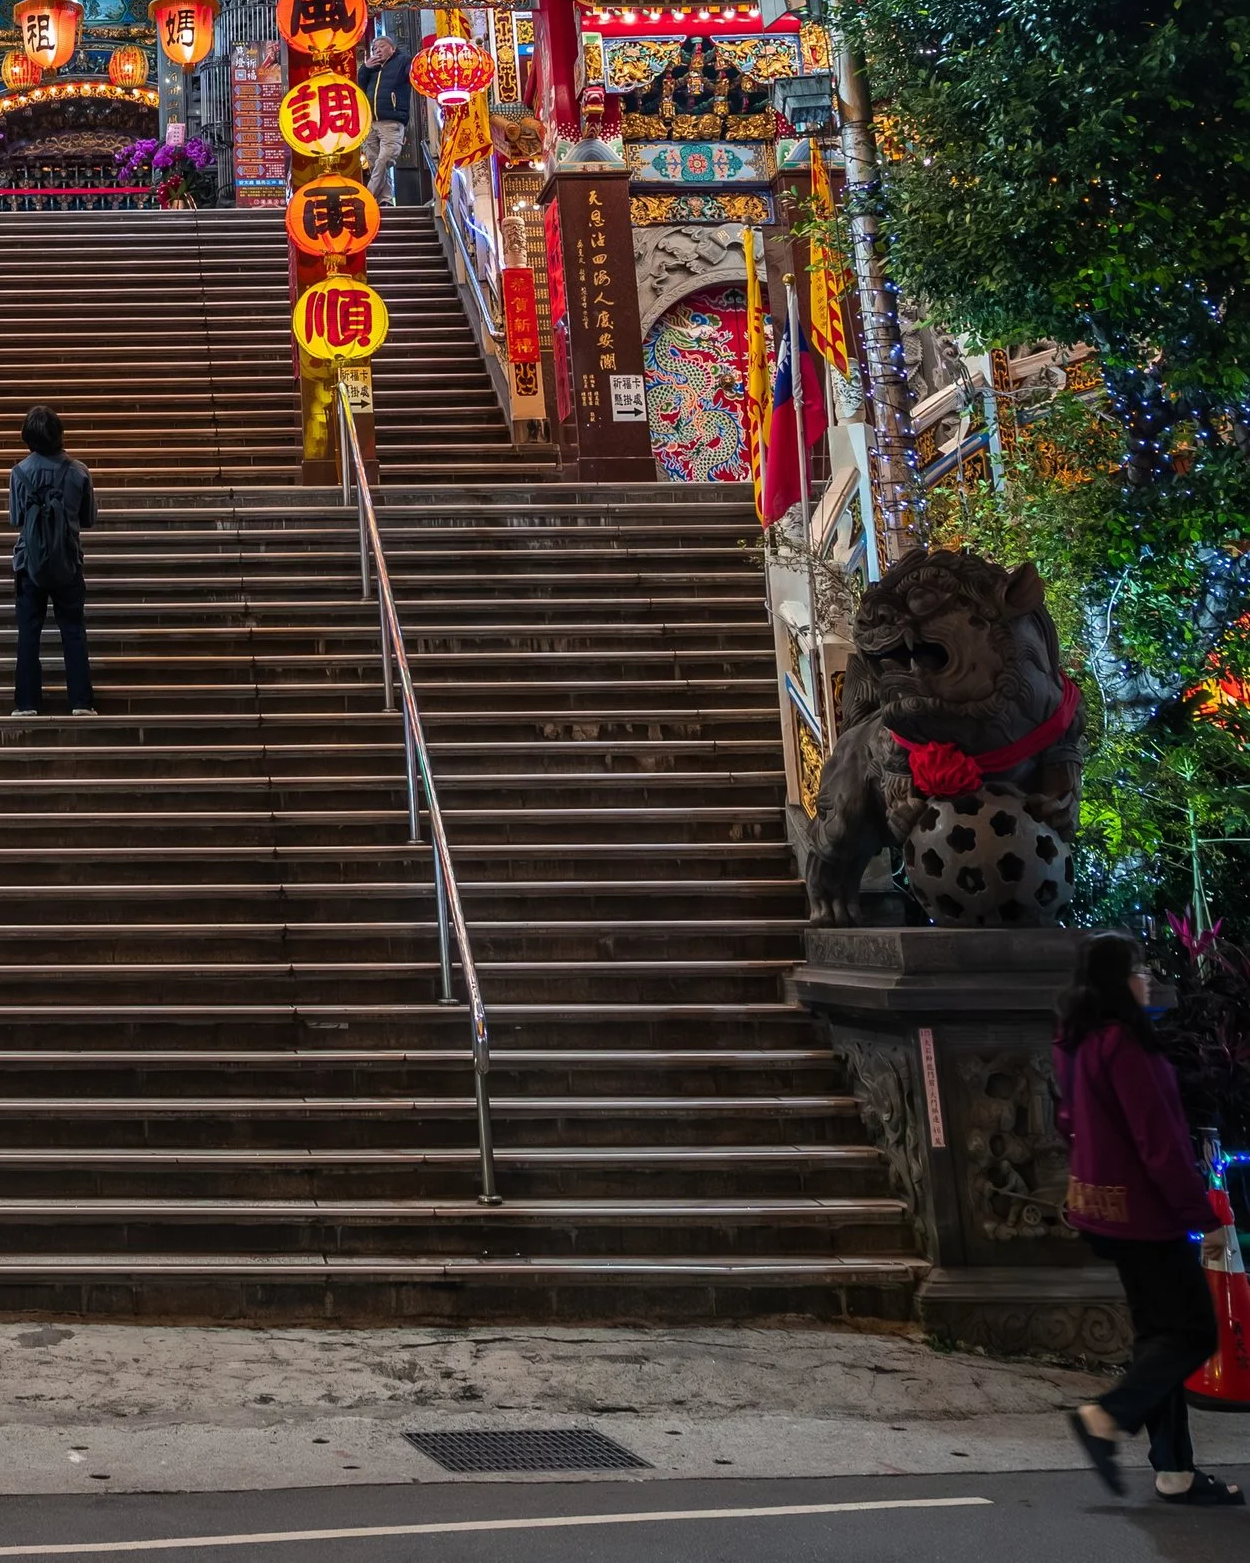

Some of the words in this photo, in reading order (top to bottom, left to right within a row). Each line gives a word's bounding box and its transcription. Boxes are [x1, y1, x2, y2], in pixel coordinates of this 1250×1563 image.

[26, 13, 56, 53] 祖
[165, 9, 196, 47] 媽
[509, 276, 536, 355] 恭賀新禧
[612, 377, 641, 390] 祈福卡
[614, 393, 643, 407] 懸掛處
